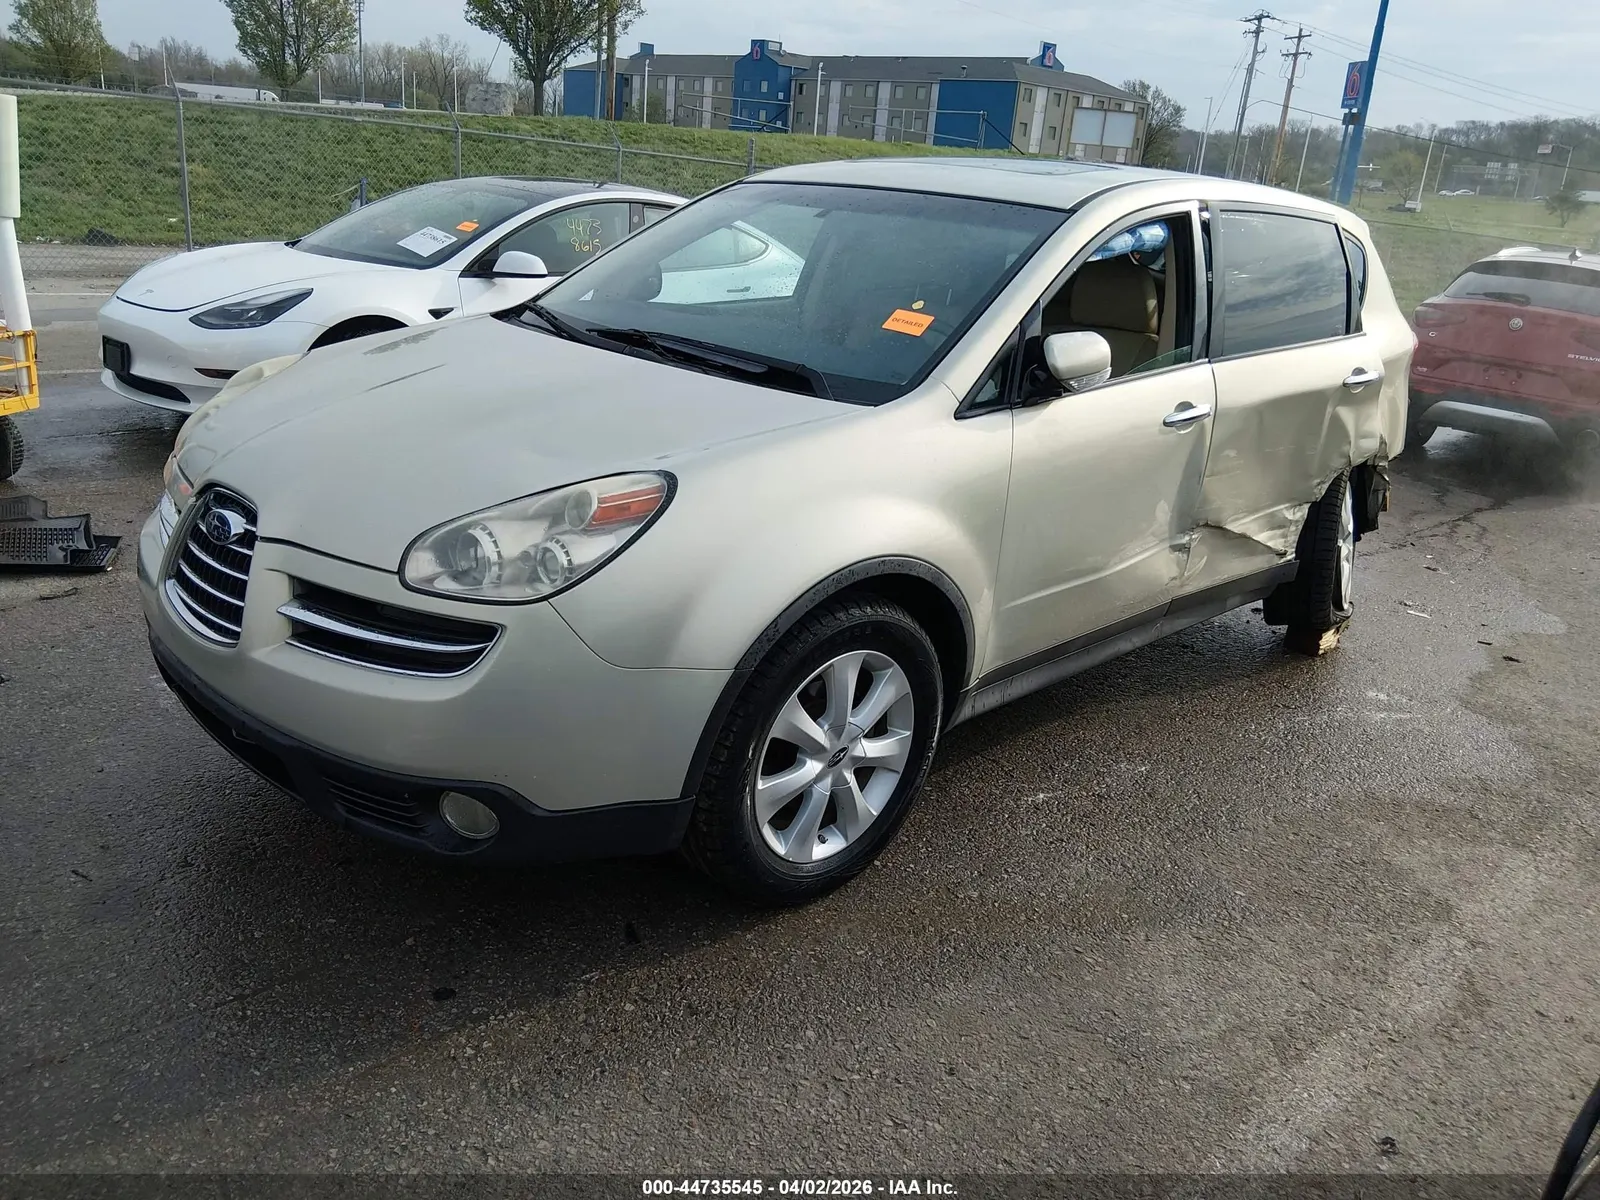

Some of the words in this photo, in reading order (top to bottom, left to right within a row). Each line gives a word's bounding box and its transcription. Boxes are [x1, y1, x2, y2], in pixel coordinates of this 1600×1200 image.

[1346, 62, 1361, 98] 6
[566, 217, 602, 236] 4473
[570, 236, 602, 256] 8615
[891, 317, 924, 328] DETAILED
